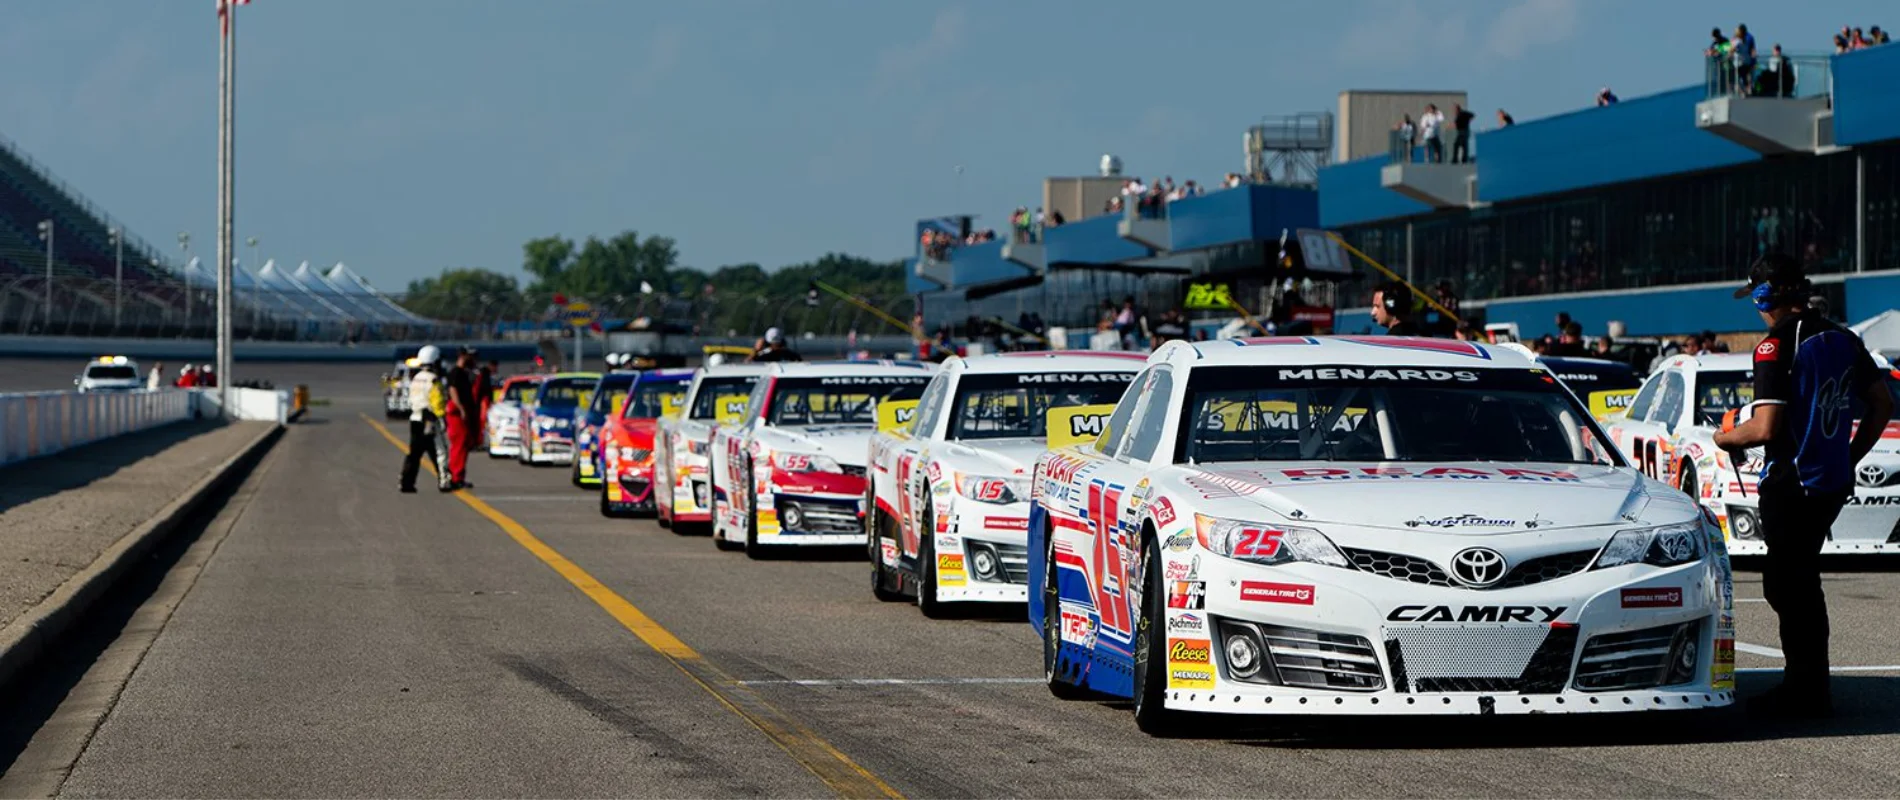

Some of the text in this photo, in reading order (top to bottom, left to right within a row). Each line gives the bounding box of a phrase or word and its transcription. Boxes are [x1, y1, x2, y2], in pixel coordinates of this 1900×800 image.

[821, 376, 925, 385] MENARDS
[1278, 368, 1479, 382] MENARDS
[786, 455, 810, 469] 55
[1280, 468, 1581, 479] DEAN
[978, 480, 1004, 499] 15
[1232, 528, 1285, 557] 25
[1167, 560, 1189, 571] Sioux
[1165, 569, 1187, 579] Chief
[1243, 588, 1297, 598] GENERAL TIRE
[1624, 593, 1669, 602] GENERAL TIRE
[1387, 605, 1568, 622] CAMRY
[1168, 617, 1203, 633] Richmond
